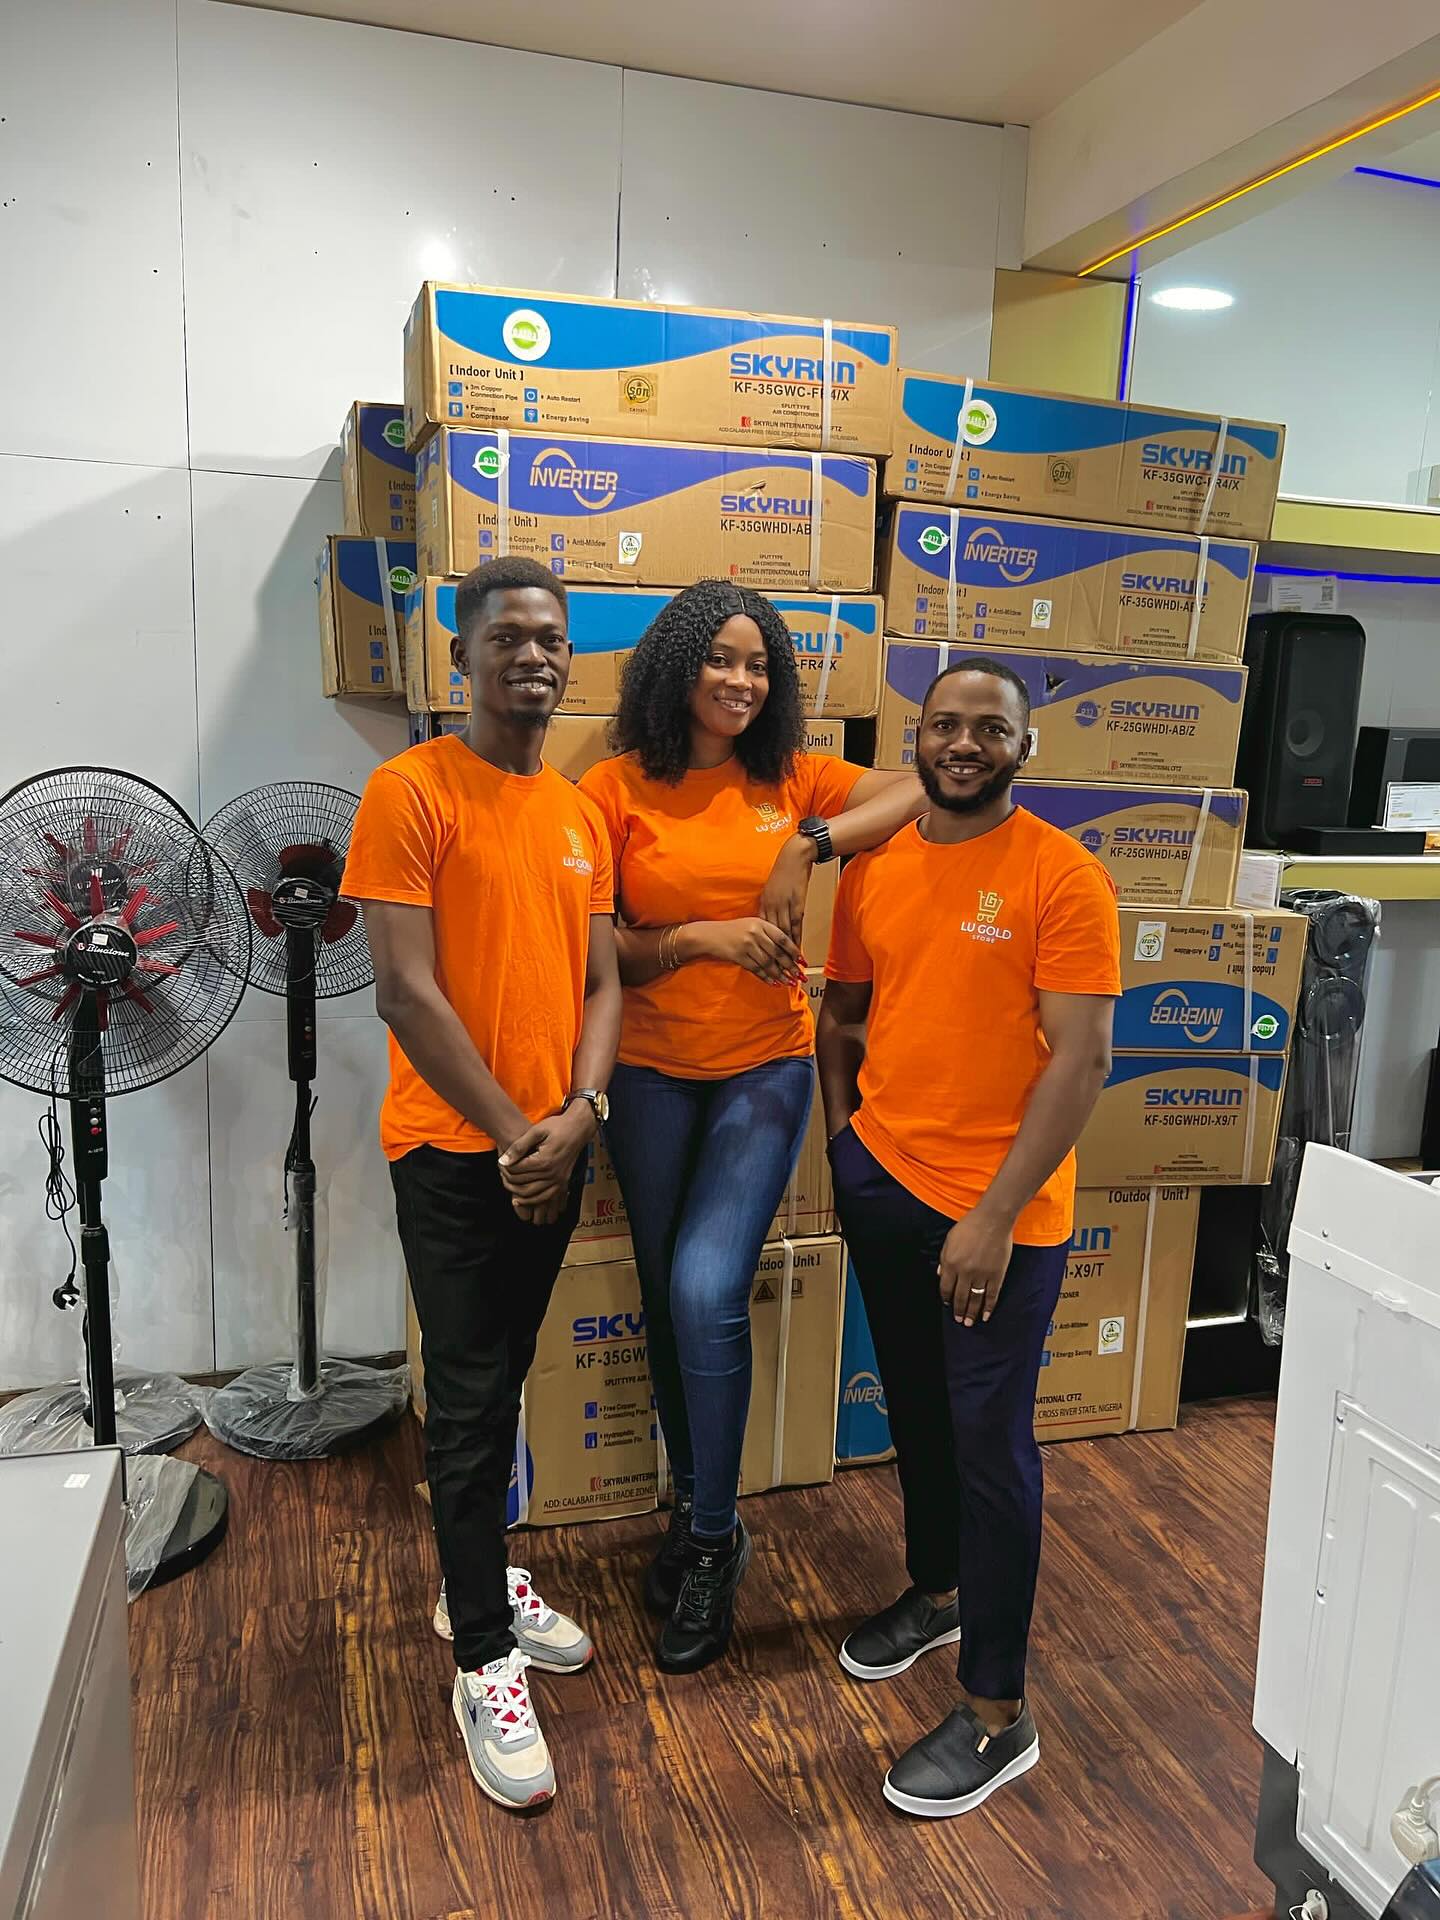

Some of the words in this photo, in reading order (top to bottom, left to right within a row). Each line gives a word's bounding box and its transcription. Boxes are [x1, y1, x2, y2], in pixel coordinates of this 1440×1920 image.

[730, 352, 856, 384] SKYRUN
[734, 381, 850, 401] KF-35GWC-F4/X
[546, 413, 568, 423] Energy
[569, 415, 590, 424] Saving
[780, 422, 822, 431] INTERNATIONA
[530, 466, 618, 491] INVERTER
[963, 543, 1037, 567] INVERTER
[790, 632, 843, 654] RUN
[1110, 700, 1200, 720] SKYRUN
[1106, 720, 1196, 736] KF-25GWHDI-AB/Z
[960, 921, 976, 932] LU
[977, 924, 1012, 940] GOLD
[86, 943, 130, 957] Binatone
[1151, 1006, 1224, 1026] INVERTER
[1145, 1088, 1242, 1106] SKYRUN
[1144, 1114, 1238, 1126] KF-50GWHDI-X9/T
[844, 1386, 883, 1405] INVER
[562, 1495, 594, 1507] CALABAR
